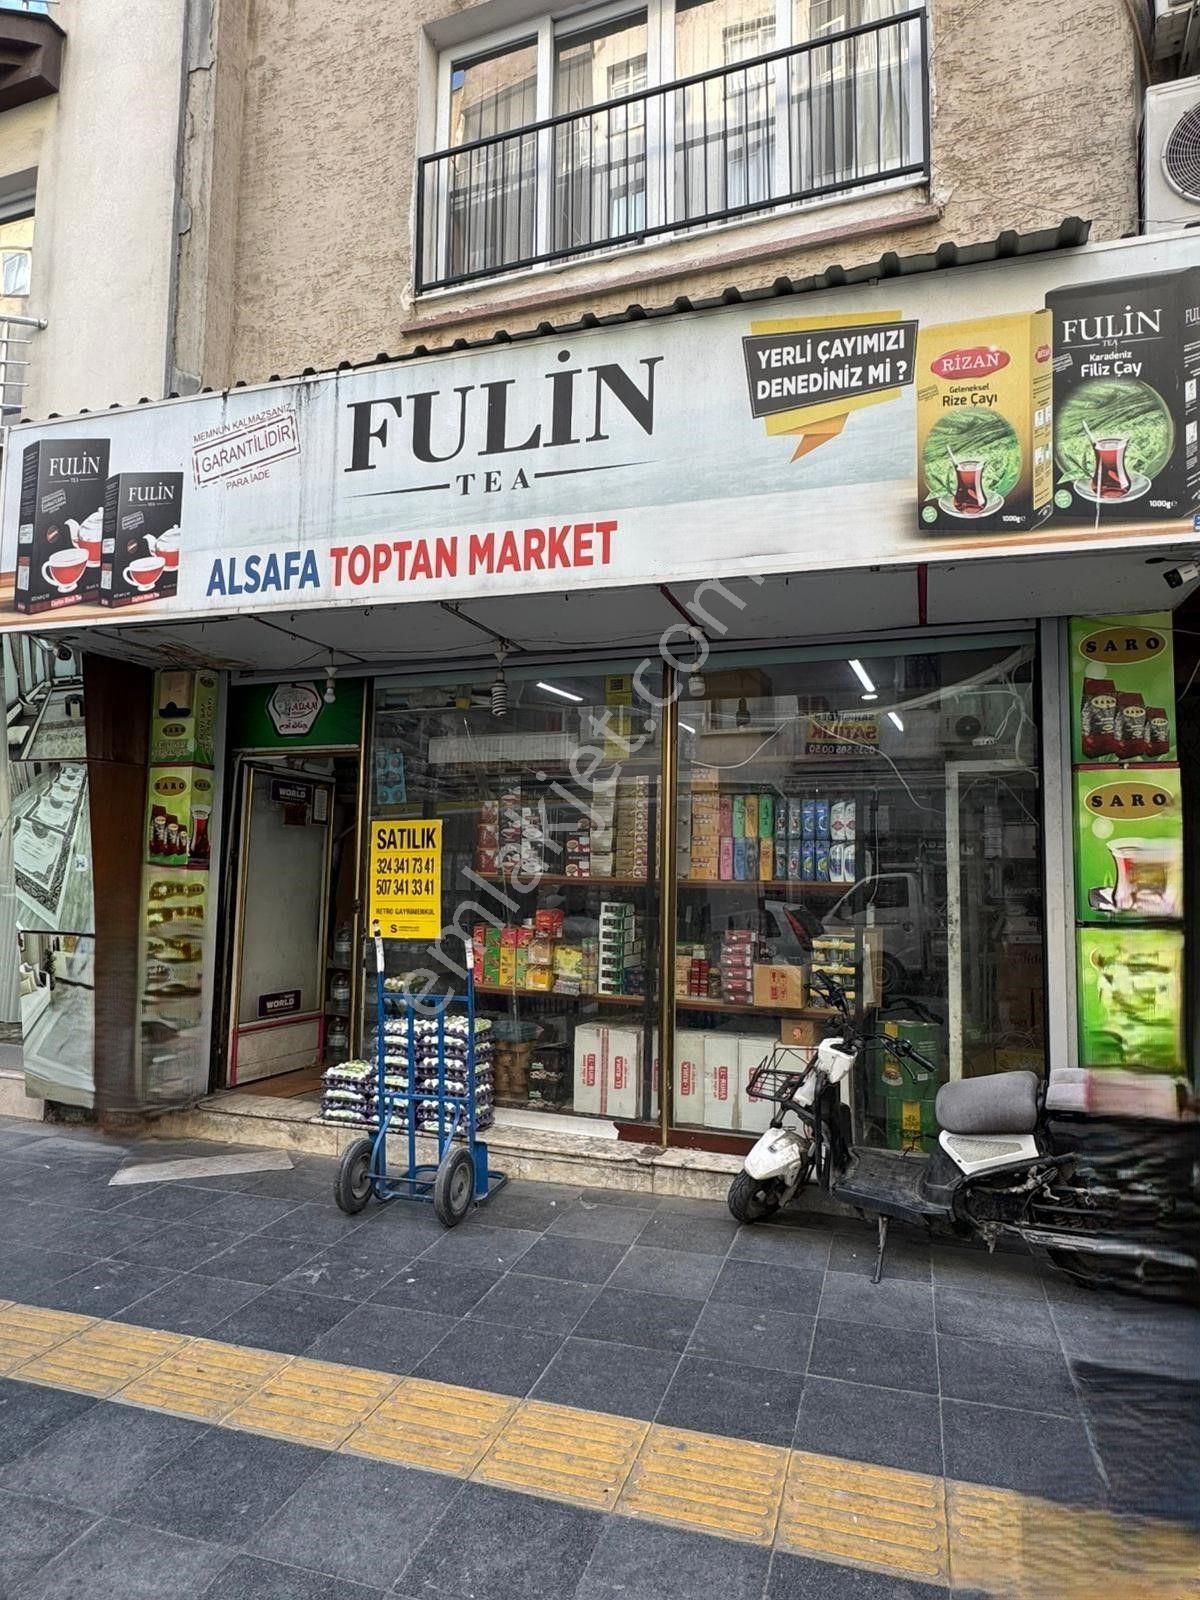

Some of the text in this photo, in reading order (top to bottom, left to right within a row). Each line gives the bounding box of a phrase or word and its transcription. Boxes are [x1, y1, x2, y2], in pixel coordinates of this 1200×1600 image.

[1062, 304, 1162, 343] FULİN
[757, 329, 905, 369] YERLİ ÇAYIMIZI
[1089, 350, 1132, 362] Karadeniz
[1081, 360, 1142, 377] Filiz Çay
[757, 364, 863, 400] DENEDİNİZ
[868, 358, 891, 385] Mİ
[949, 383, 990, 394] Geleneksel
[942, 393, 998, 407] Rize Çayı
[344, 349, 664, 472] FULİN
[193, 424, 231, 443] MEMNUN
[202, 424, 292, 473] GARANTİLİDİR
[49, 451, 101, 477] FULİN
[226, 477, 249, 490] PARA
[456, 468, 531, 496] TEA
[128, 482, 175, 502] FULİN
[206, 520, 618, 597] ALSAFA TOPTAN MARKET
[1086, 637, 1160, 653] SARO
[279, 788, 306, 798] WORLD
[1091, 793, 1167, 808] SARO
[377, 828, 436, 850] SATILIK
[376, 857, 434, 874] 324 341 73 41
[376, 879, 434, 895] 507 341 33 41
[266, 998, 294, 1009] WORLD
